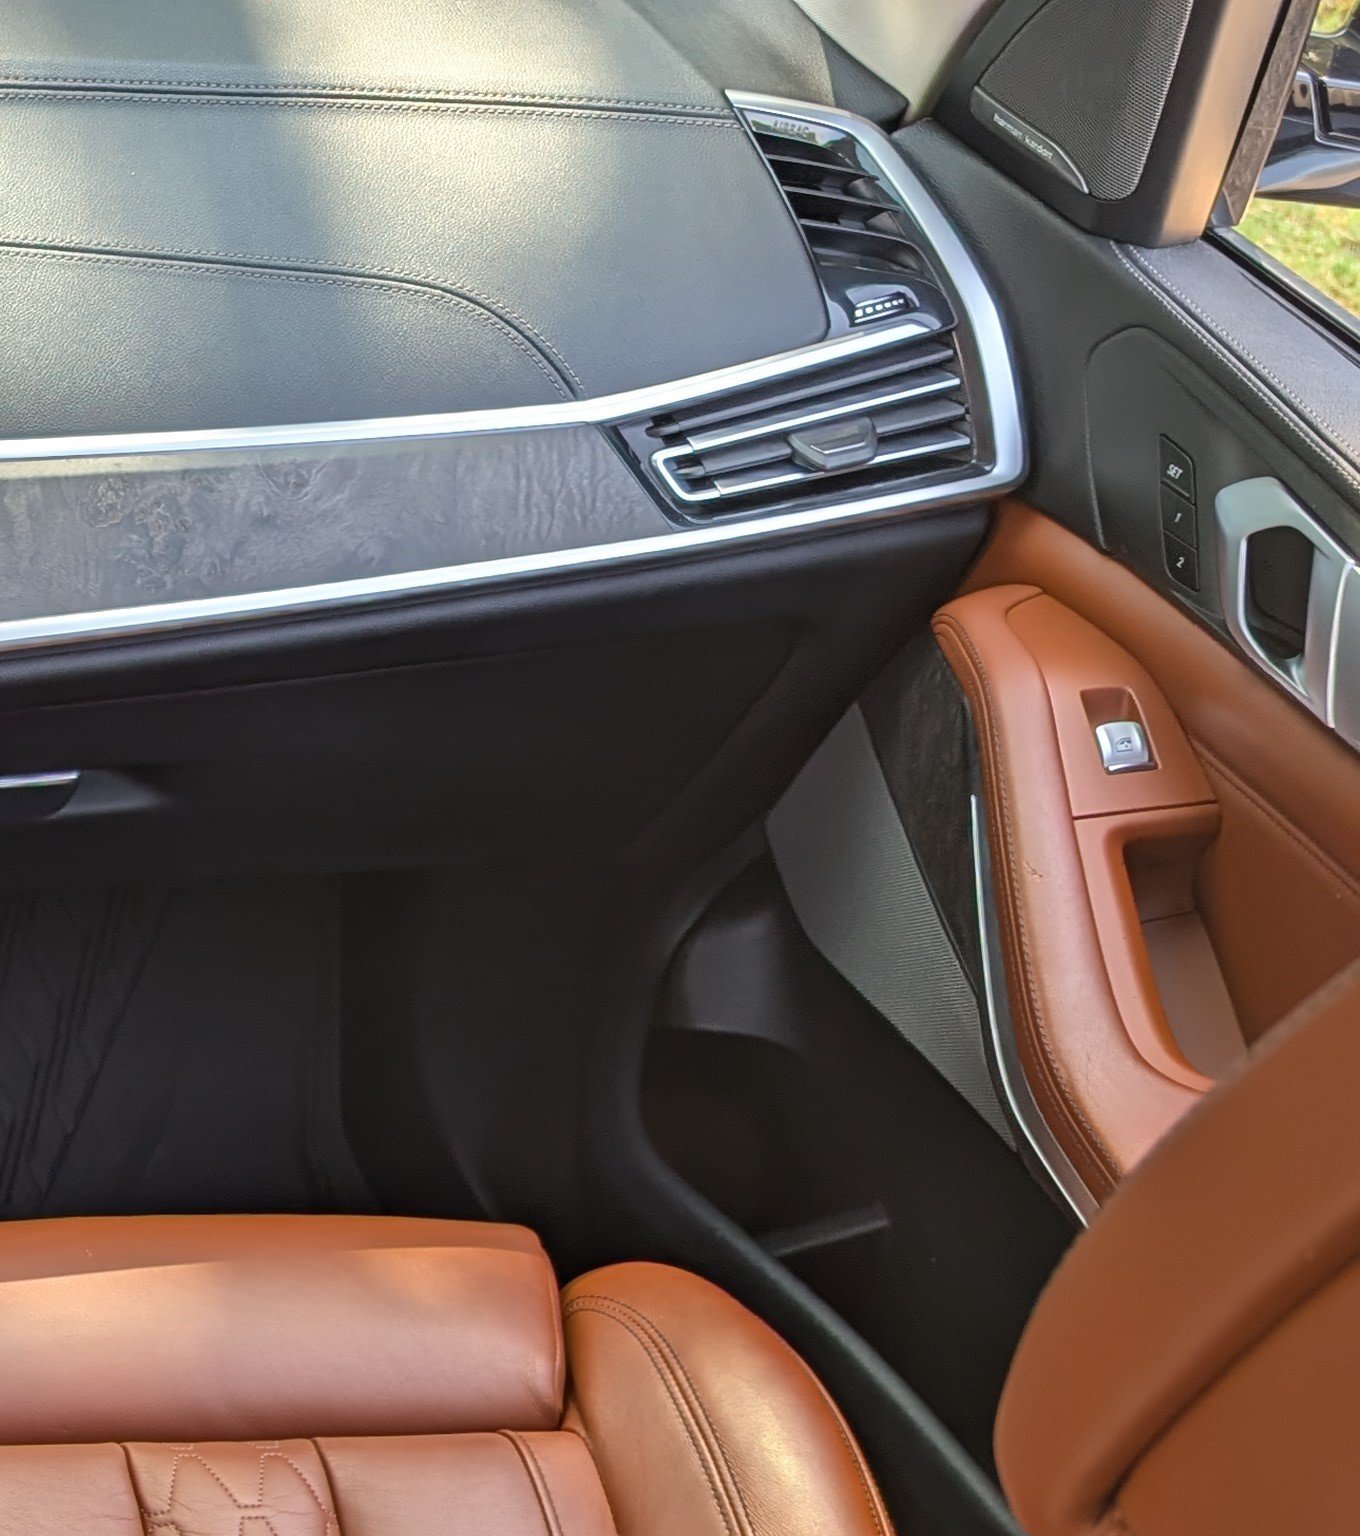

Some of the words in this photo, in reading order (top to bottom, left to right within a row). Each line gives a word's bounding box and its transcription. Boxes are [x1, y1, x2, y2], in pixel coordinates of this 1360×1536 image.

[1167, 464, 1183, 479] SET
[1174, 513, 1181, 523] 1
[1176, 557, 1184, 568] 2
